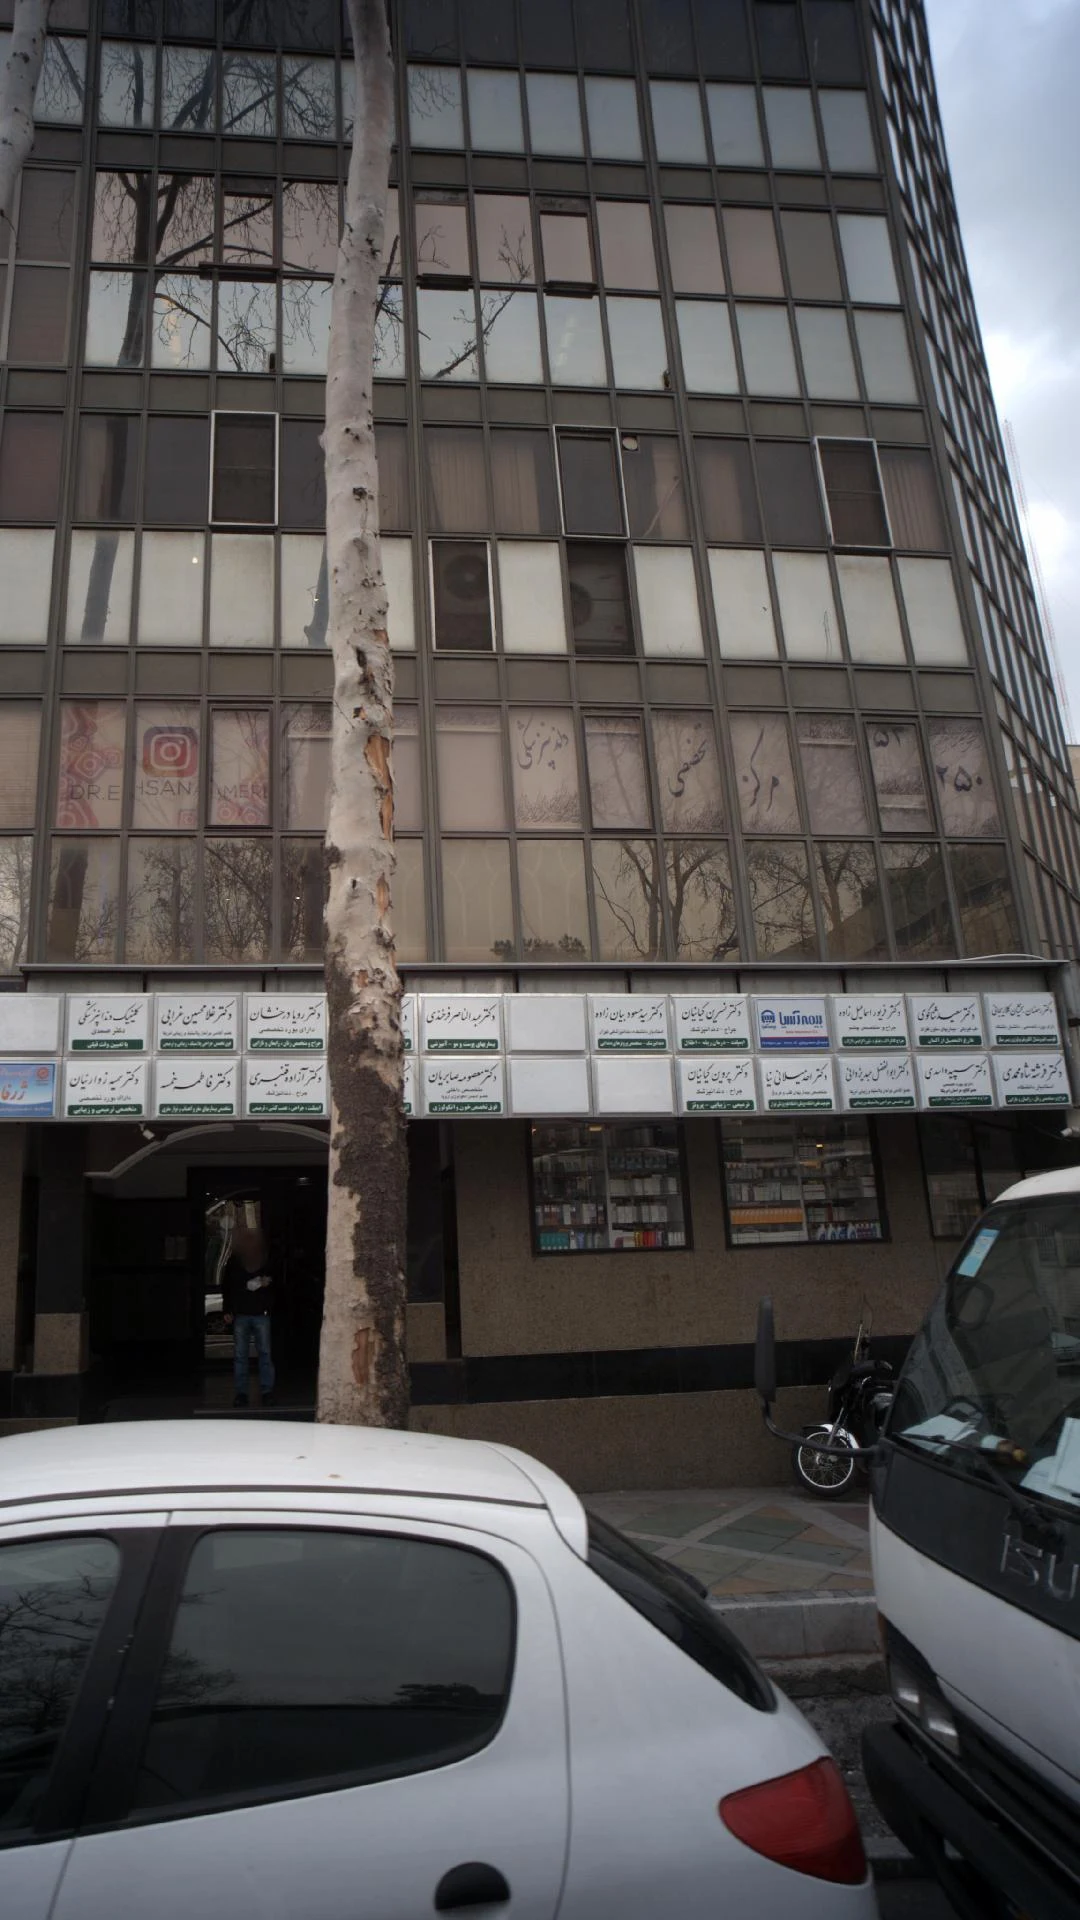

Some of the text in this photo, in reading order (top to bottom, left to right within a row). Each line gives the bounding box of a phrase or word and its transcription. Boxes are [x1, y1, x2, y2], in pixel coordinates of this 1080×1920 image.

[667, 722, 708, 799] تخصصی
[740, 727, 780, 812] مرکز
[78, 1000, 143, 1027] کلینیک دندانپزشکی
[213, 1000, 235, 1024] دکتر
[249, 1000, 324, 1024] دکتر رویا درخشان
[478, 1003, 497, 1025] دکتر
[645, 1001, 664, 1022] دکتر
[706, 1002, 728, 1024] نسرین
[726, 1000, 745, 1020] دکتر
[885, 1001, 901, 1020] دکتر
[937, 1010, 963, 1023] سعید
[960, 1003, 975, 1023] دکتر
[1039, 1001, 1053, 1017] دکتر
[119, 1065, 143, 1089] دکتر
[210, 1066, 234, 1092] دکتر
[249, 1063, 324, 1088] دکتر آزاده قنبری
[456, 1070, 484, 1082] معصومه
[480, 1063, 498, 1086] دکتر
[711, 1071, 733, 1084] پروین
[733, 1061, 750, 1081] دکتر
[811, 1062, 829, 1085] دکتر
[895, 1059, 909, 1081] دکتر
[924, 1067, 943, 1080] اسدی
[971, 1059, 987, 1079] دکتر
[1002, 1067, 1021, 1082] محمدی
[1030, 1063, 1047, 1080] فرشته
[1046, 1058, 1062, 1082] دکتر
[172, 1071, 213, 1091] فاطمه
